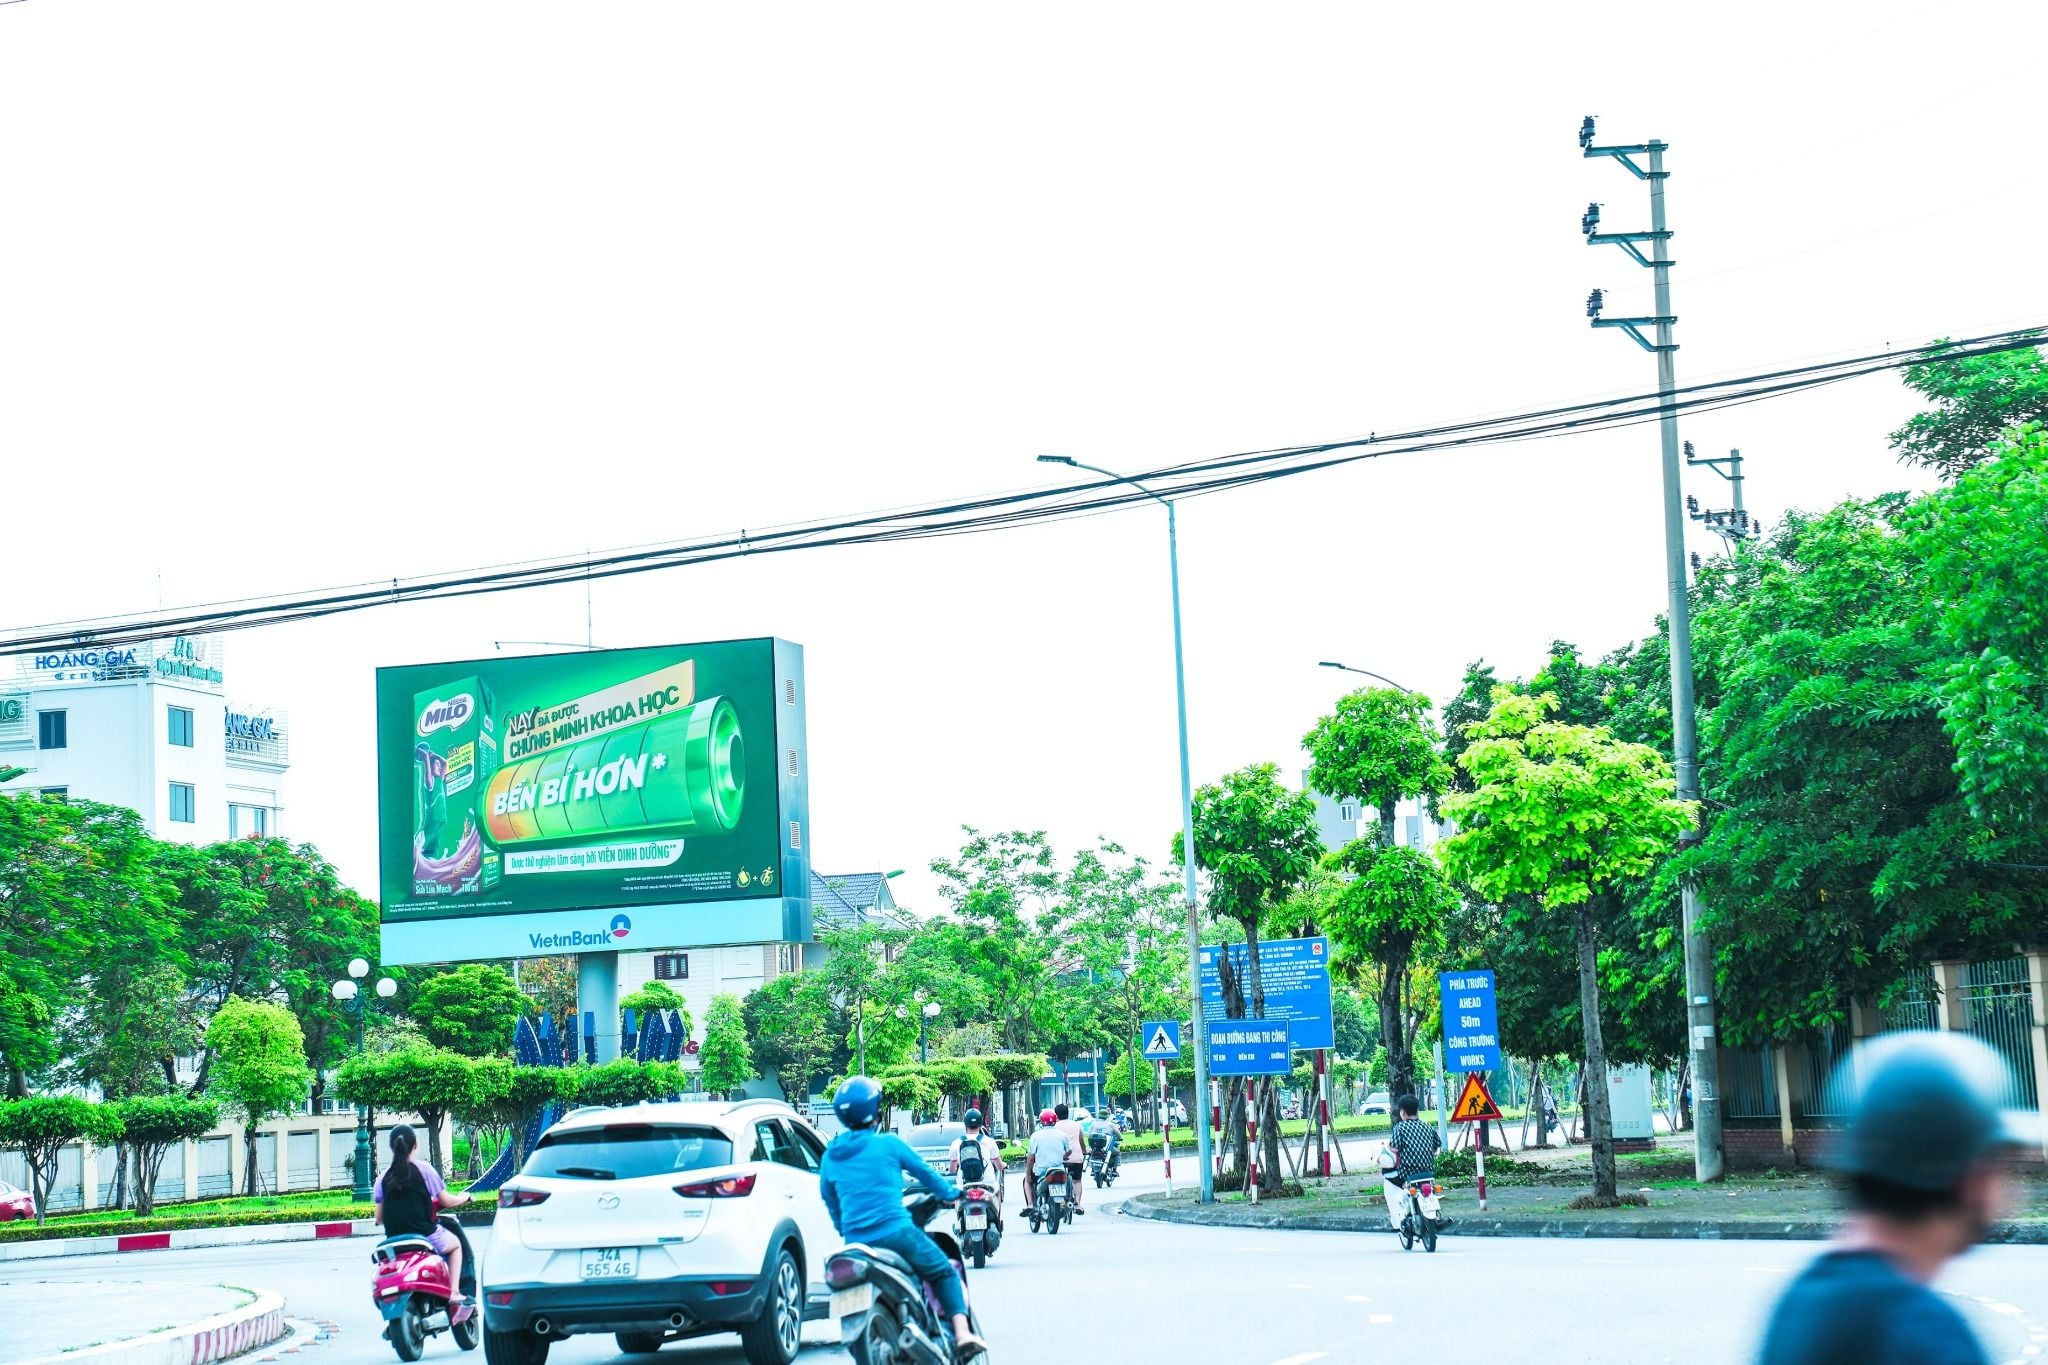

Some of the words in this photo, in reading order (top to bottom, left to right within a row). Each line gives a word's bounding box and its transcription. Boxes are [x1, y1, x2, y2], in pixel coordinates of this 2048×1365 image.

[105, 651, 135, 664] GIA
[0, 699, 20, 720] G
[425, 703, 468, 727] MILO
[509, 707, 540, 737] NAY
[538, 712, 550, 727] ĐÃ
[552, 703, 579, 722] ĐƯỢC
[510, 731, 551, 759] CHỨNG
[553, 717, 588, 744] MINH
[590, 701, 636, 732] KHOA
[639, 685, 680, 715] HỌC
[617, 848, 638, 861] DINH
[529, 929, 612, 949] VietinBank
[1449, 977, 1466, 991] PHÍA
[1466, 975, 1489, 990] TRƯỚC
[1459, 996, 1482, 1009] AHEAD
[1461, 1016, 1481, 1028] 50m
[1262, 1031, 1271, 1043] THI
[1271, 1028, 1287, 1042] CÔNG
[1448, 1035, 1468, 1049] CÔNG
[1468, 1032, 1496, 1048] TRƯỜNG
[1460, 1054, 1485, 1067] WORKS
[597, 1248, 620, 1261] 34A
[586, 1262, 630, 1275] 565.46
